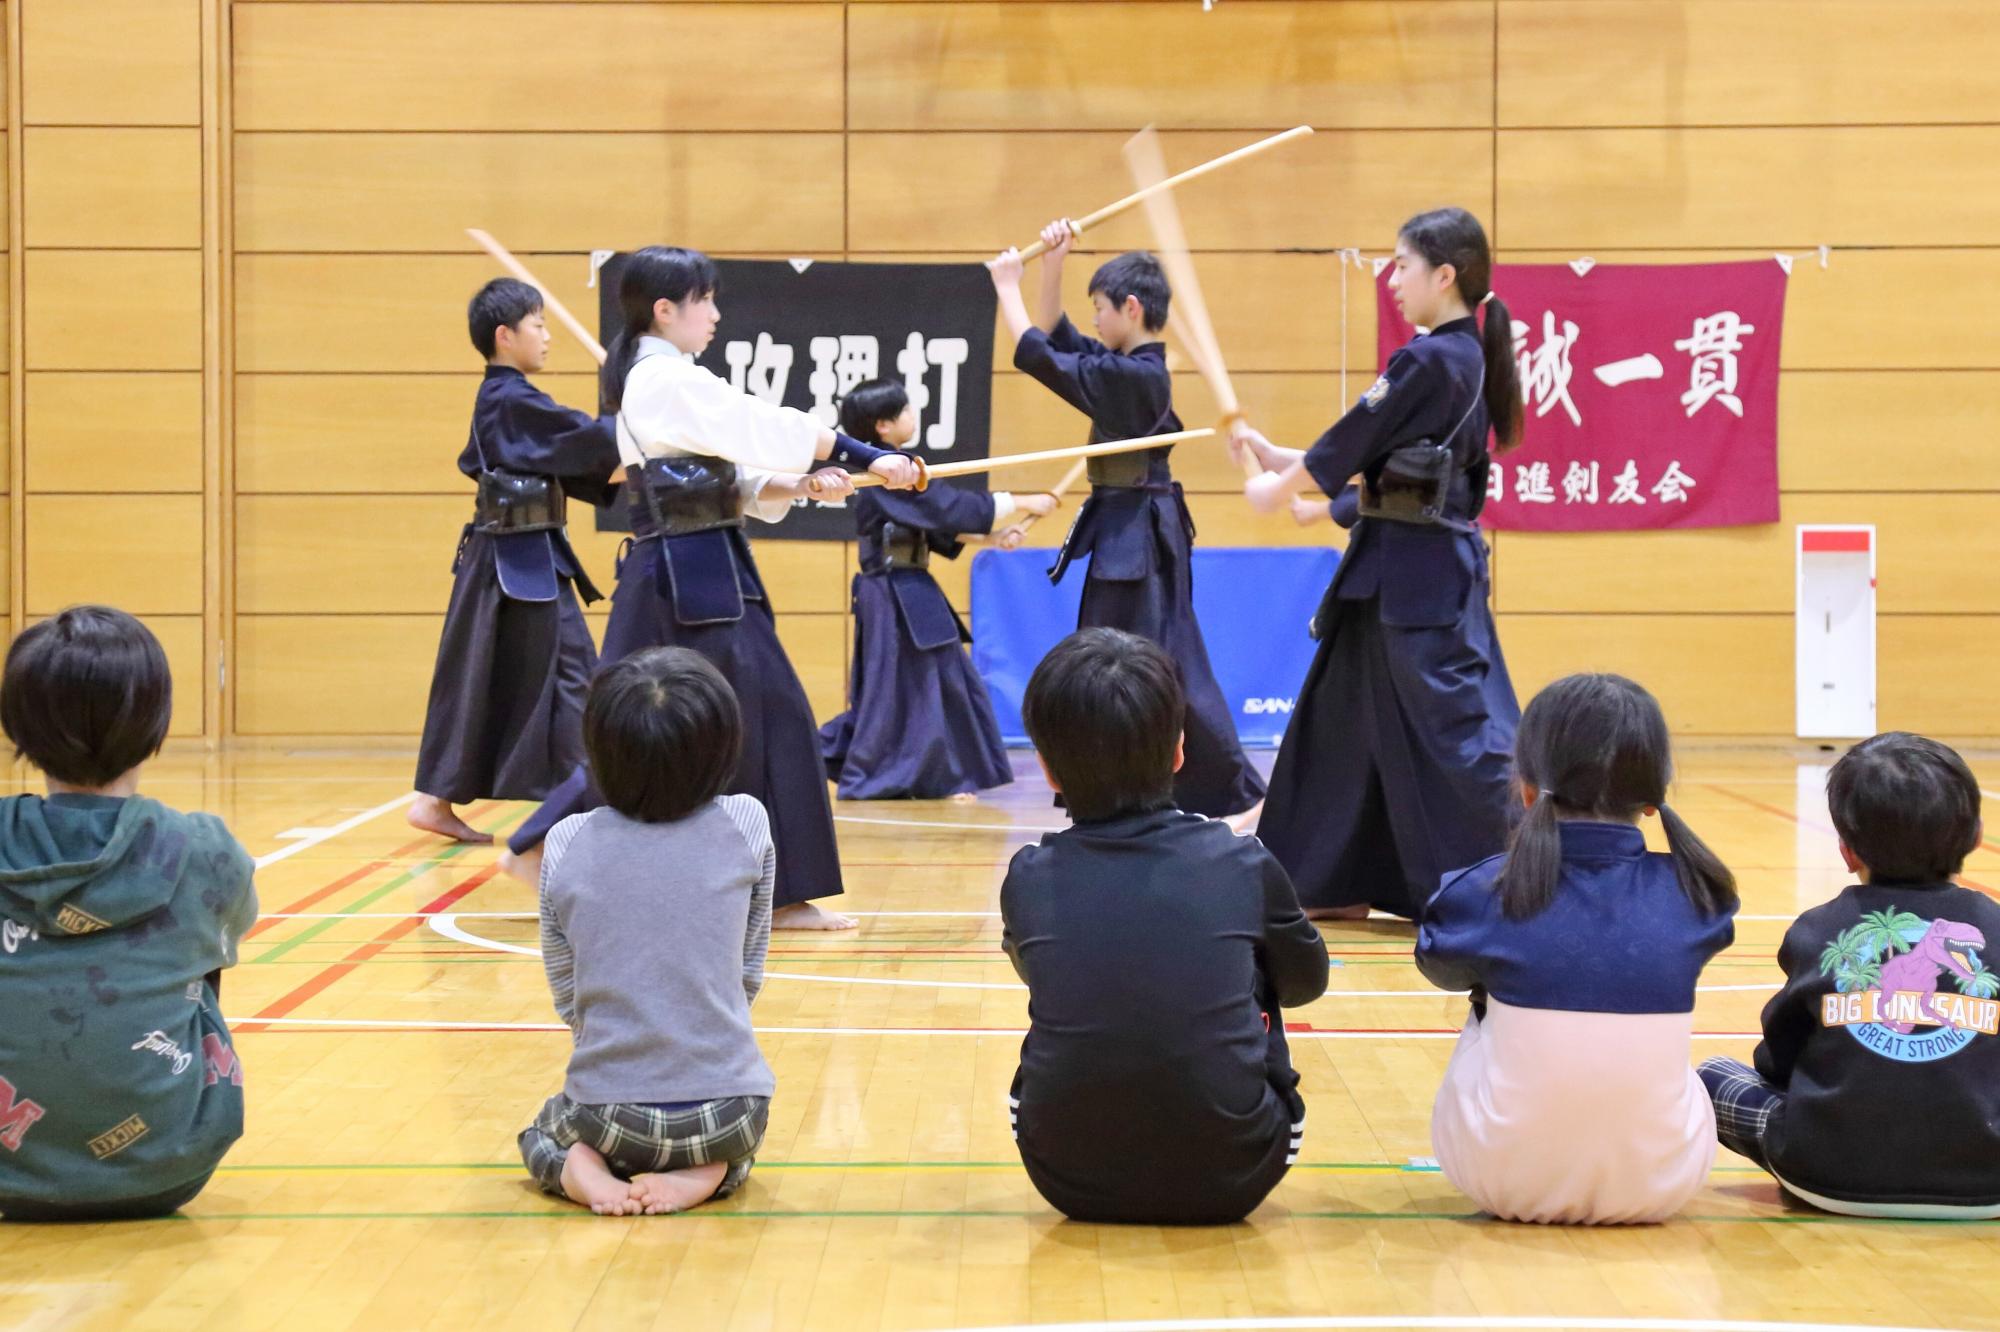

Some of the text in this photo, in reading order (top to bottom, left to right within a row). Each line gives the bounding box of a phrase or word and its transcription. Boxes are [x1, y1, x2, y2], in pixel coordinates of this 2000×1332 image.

[1415, 311, 1755, 428] 誠一貫
[692, 331, 969, 450] 攻理打
[57, 906, 105, 934] MICK
[1826, 993, 1862, 1024] BIG
[1857, 1023, 1965, 1058] GREAT STRONG
